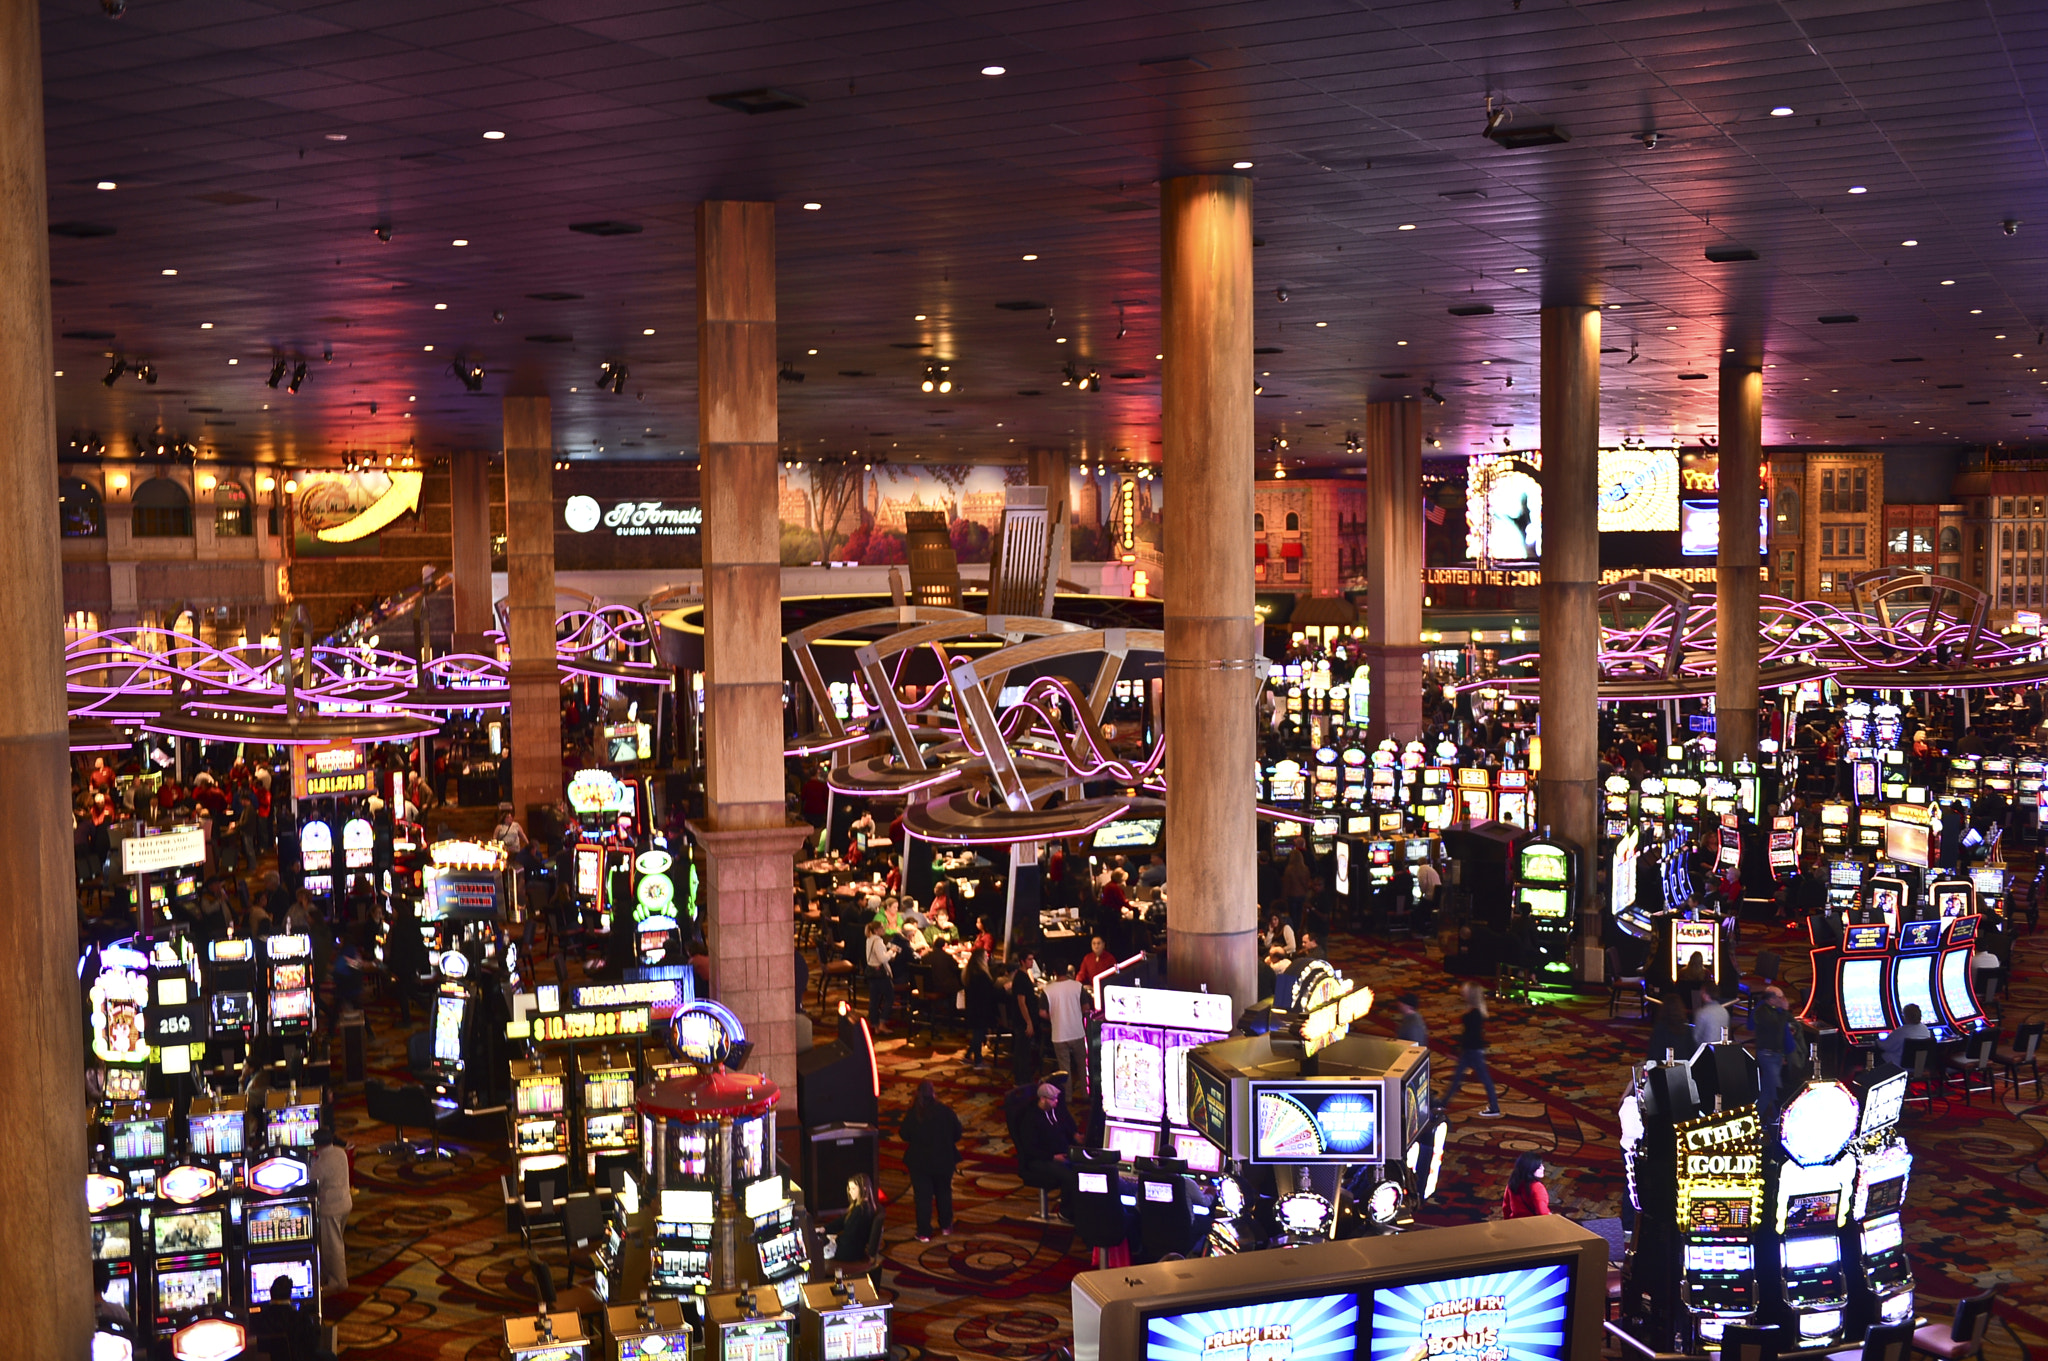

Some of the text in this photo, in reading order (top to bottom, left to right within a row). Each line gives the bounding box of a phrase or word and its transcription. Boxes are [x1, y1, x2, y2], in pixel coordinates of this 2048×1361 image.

[1599, 456, 1675, 506] nasonic
[655, 526, 697, 535] ITALIANA
[1428, 569, 1470, 585] LOCATED
[1471, 570, 1482, 585] IN
[1484, 570, 1504, 586] THE
[1700, 1120, 1745, 1147] THE
[1692, 1155, 1752, 1174] GOLD
[1425, 1295, 1506, 1320] FRENCH FRY
[1205, 1323, 1292, 1350] FRENCH FRY
[1427, 1329, 1498, 1355] BONUS
